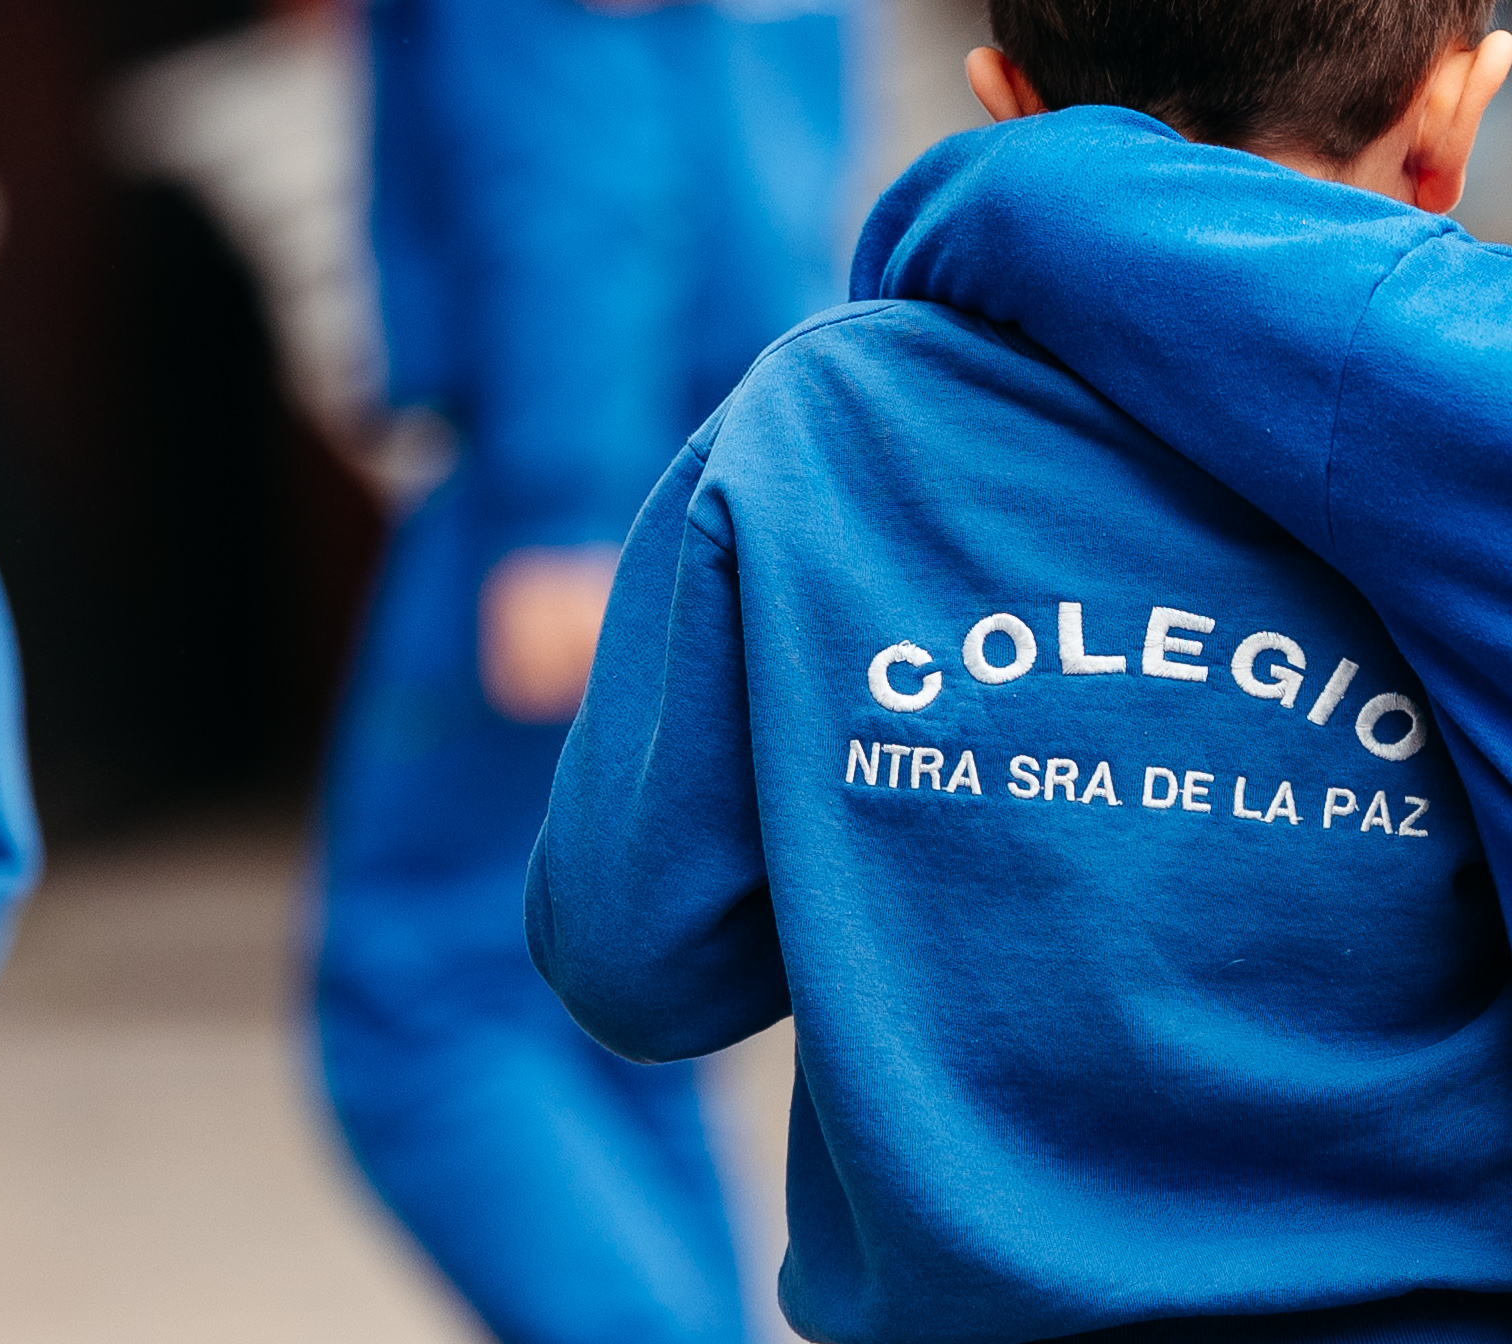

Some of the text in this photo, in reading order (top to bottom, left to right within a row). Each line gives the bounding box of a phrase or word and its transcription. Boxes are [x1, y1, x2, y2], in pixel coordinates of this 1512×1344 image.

[868, 601, 1428, 761] COLEGIO
[845, 739, 1430, 837] NTRA SRA DE LA PAZ
